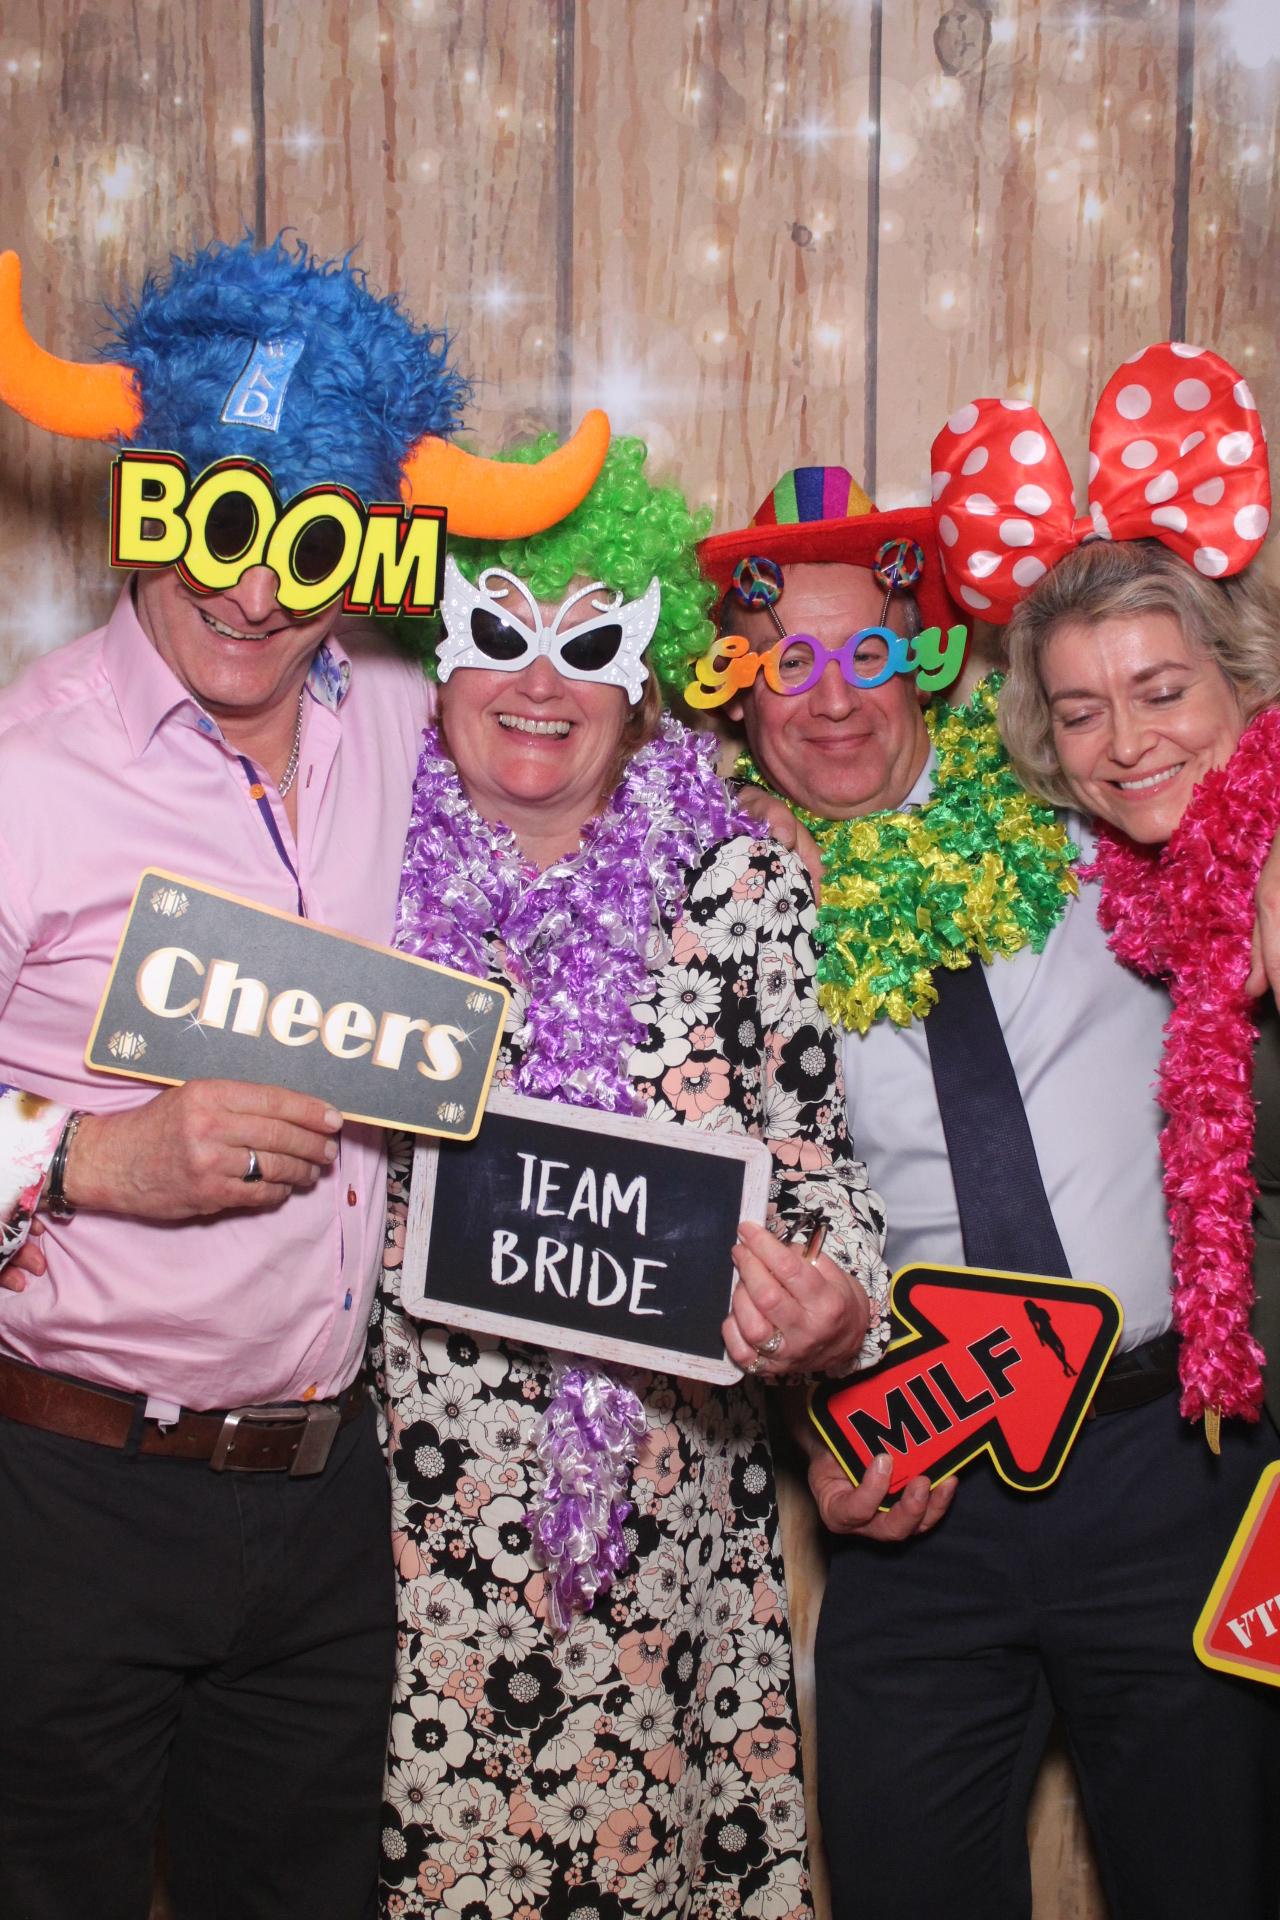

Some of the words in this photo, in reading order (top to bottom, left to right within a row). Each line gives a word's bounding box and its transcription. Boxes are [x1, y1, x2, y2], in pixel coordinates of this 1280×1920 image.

[112, 452, 447, 616] BOOM
[135, 946, 466, 1081] Cheers
[516, 1152, 647, 1236] TEAM
[490, 1229, 668, 1315] BRIDE
[846, 1325, 1023, 1457] MILF
